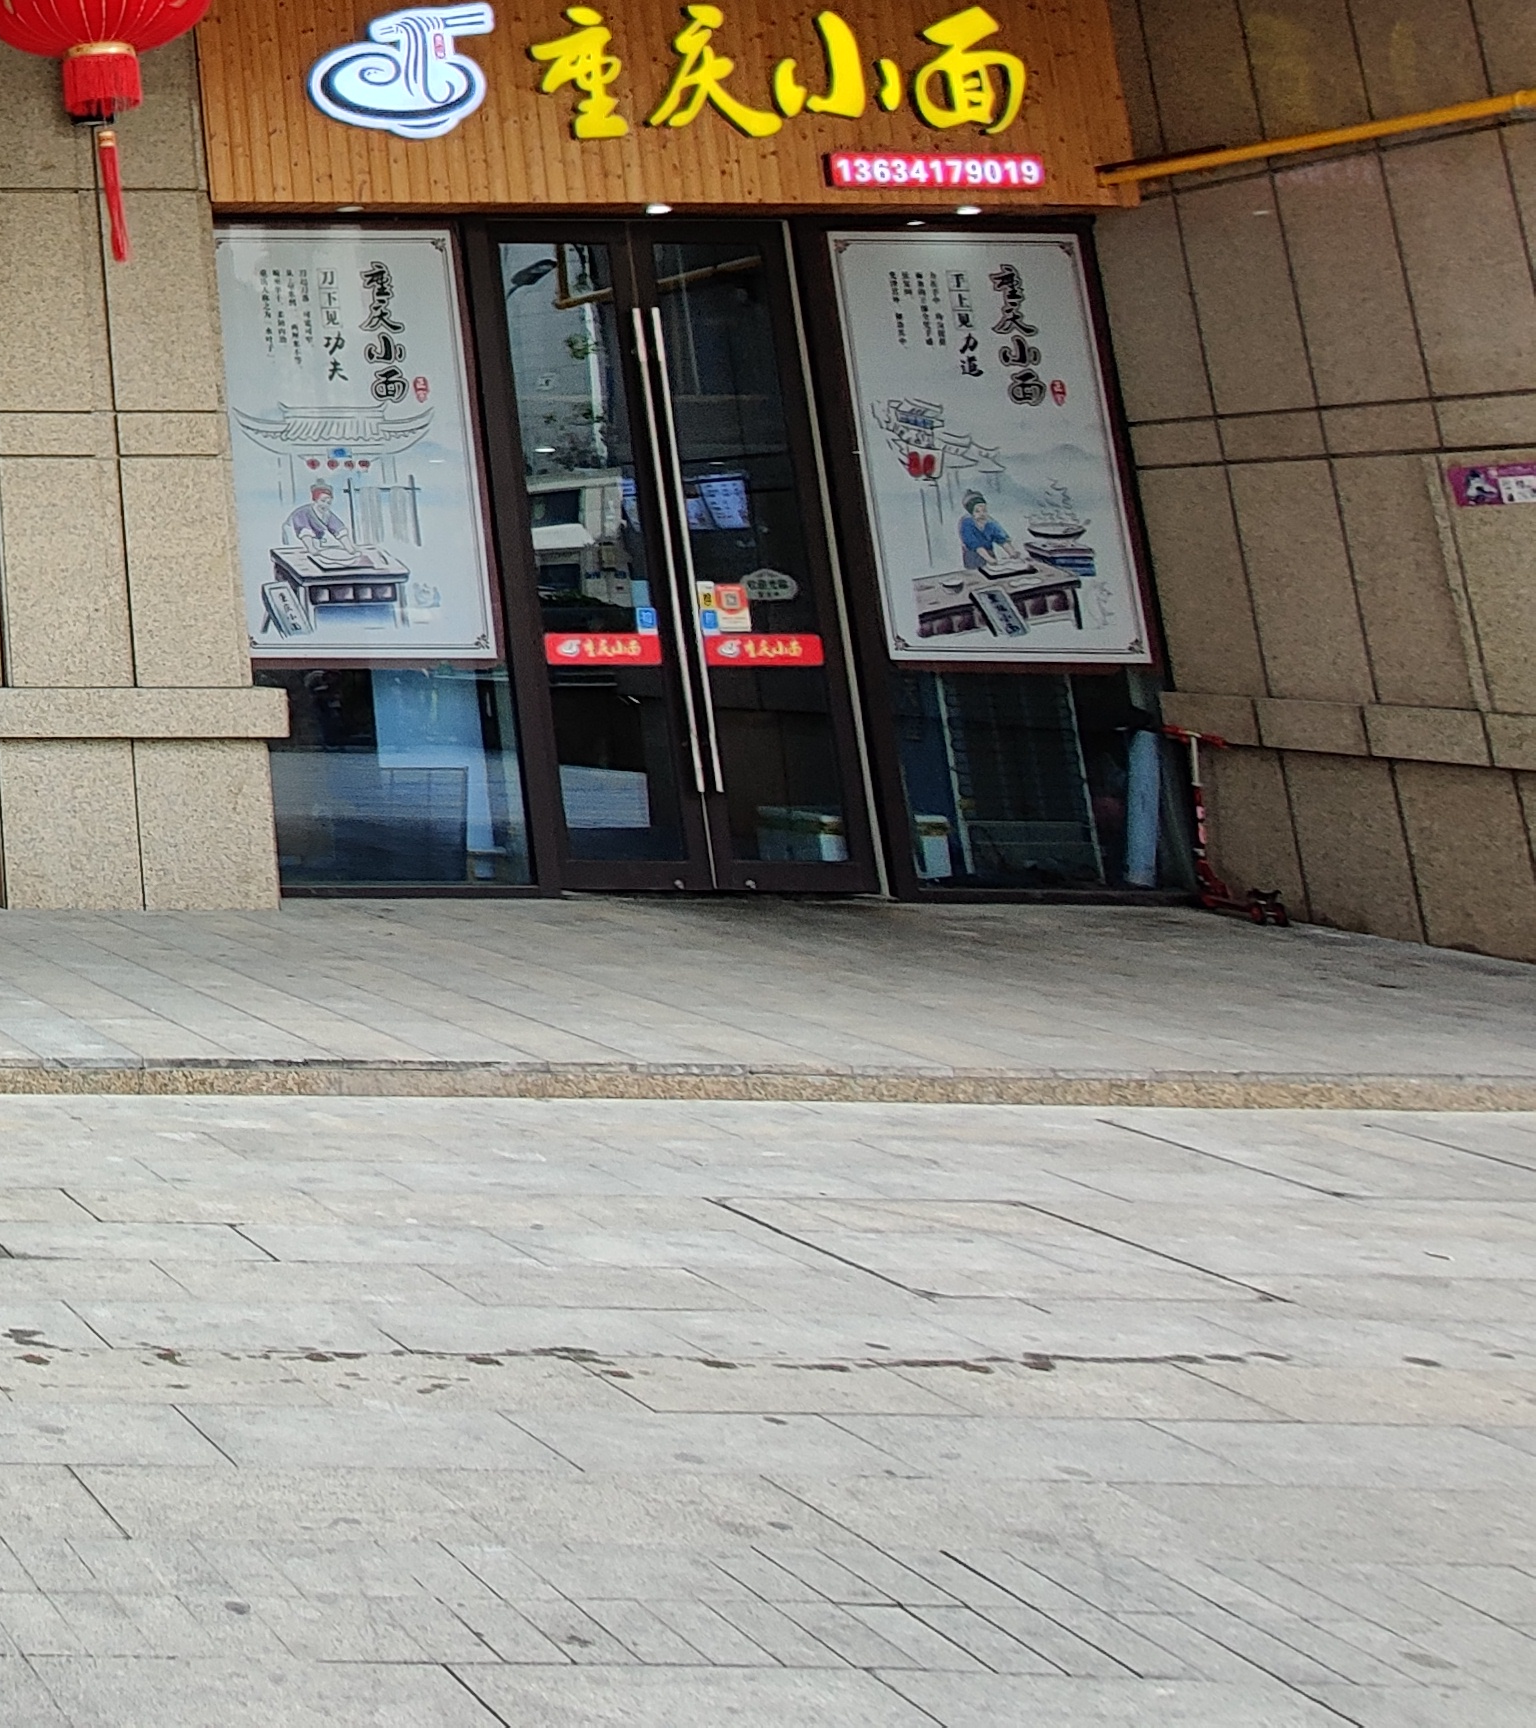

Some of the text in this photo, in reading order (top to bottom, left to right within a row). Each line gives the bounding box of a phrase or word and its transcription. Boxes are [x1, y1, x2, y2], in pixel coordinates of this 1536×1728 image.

[530, 3, 1026, 139] 重庆小面
[835, 156, 1041, 189] 13634179019
